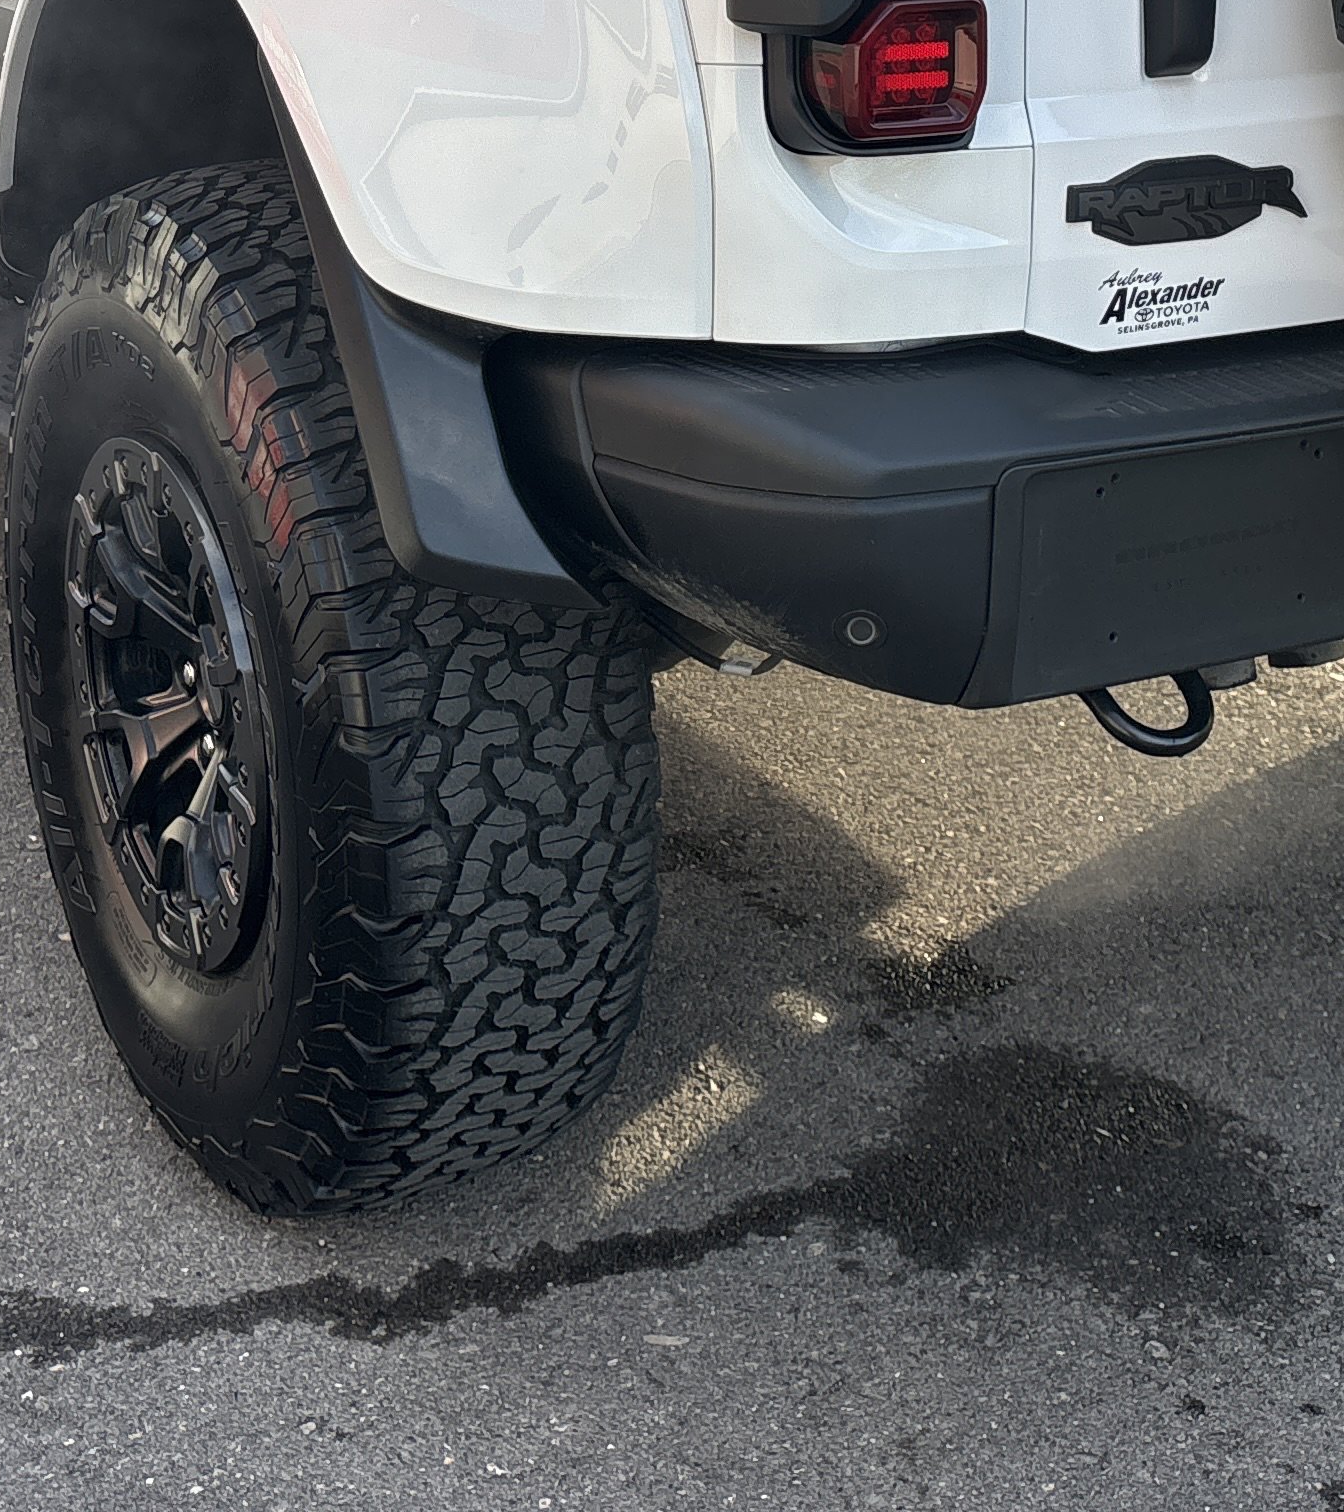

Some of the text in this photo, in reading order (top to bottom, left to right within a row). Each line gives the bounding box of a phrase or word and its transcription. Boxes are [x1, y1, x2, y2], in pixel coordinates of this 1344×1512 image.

[1074, 168, 1308, 238] RAPTOR
[1098, 268, 1162, 290] Aubrey
[1099, 276, 1226, 326] Alexander
[1156, 300, 1210, 319] TOYOTA
[1117, 315, 1199, 335] SELINSGROVE, PA
